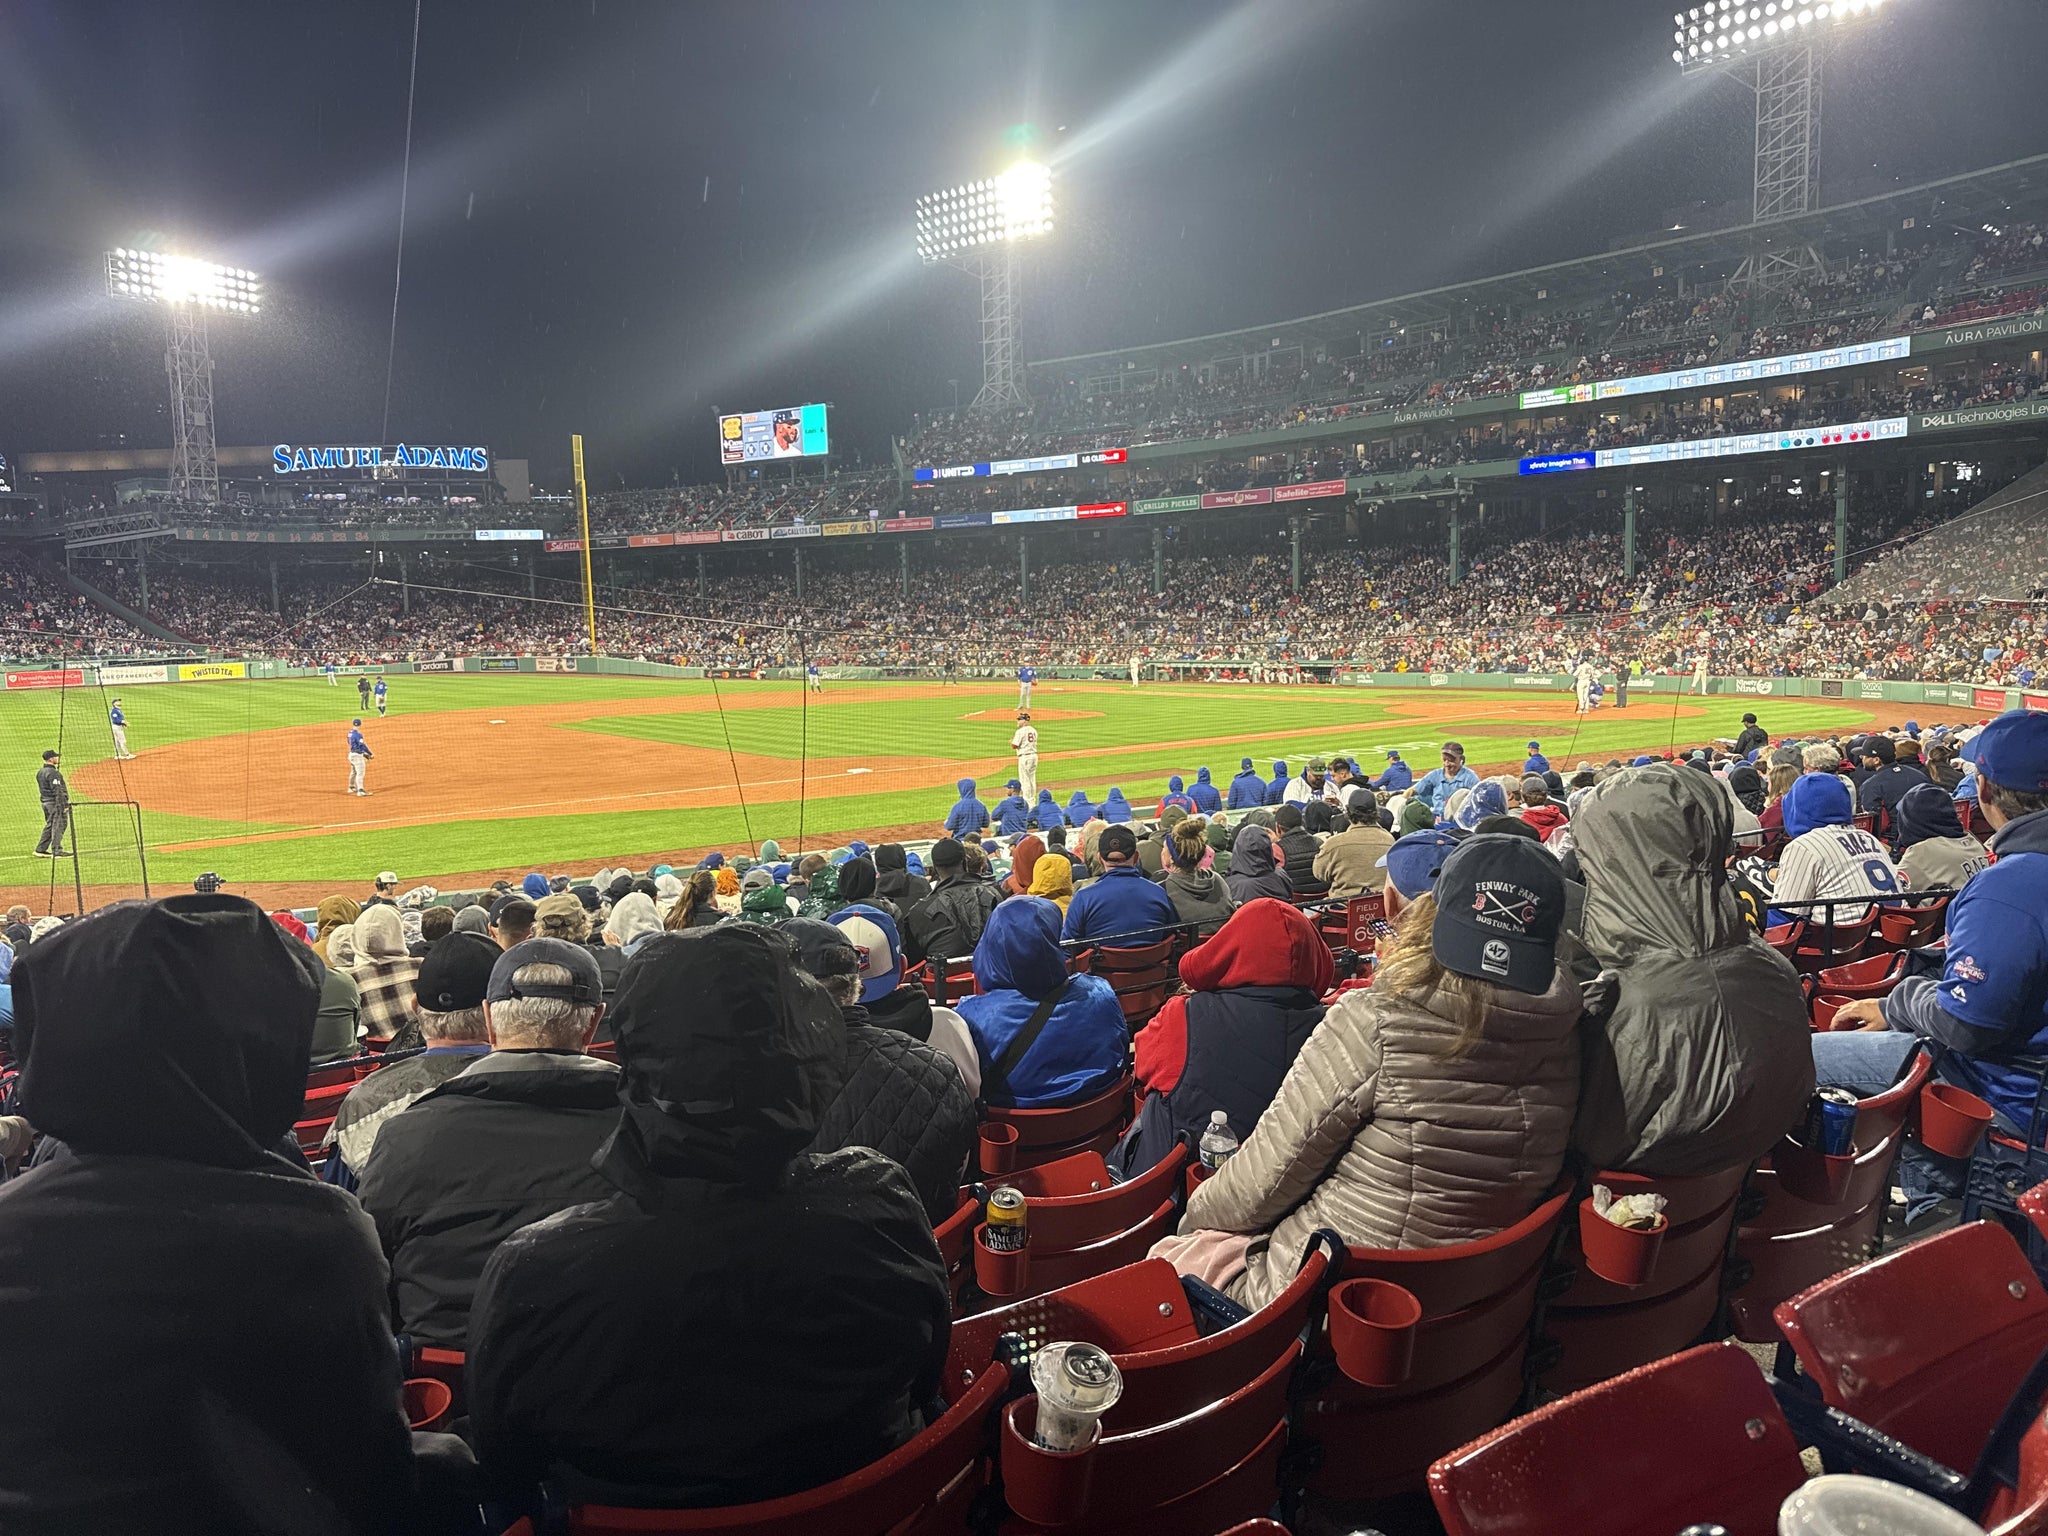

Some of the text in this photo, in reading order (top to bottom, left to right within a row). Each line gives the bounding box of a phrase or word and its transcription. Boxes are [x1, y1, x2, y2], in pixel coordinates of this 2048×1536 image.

[1986, 320, 2042, 338] PAVILION
[1602, 386, 1625, 396] STORY
[1419, 408, 1453, 420] PAVILION
[1922, 414, 1955, 428] DELL
[1955, 406, 2028, 424] Technologies
[1819, 425, 1845, 434] STRIKE
[1852, 423, 1868, 431] OUT
[1881, 422, 1903, 434] 6TH
[1740, 439, 1758, 448] MVR
[273, 443, 488, 473] SAMUEL ADAMS
[1529, 457, 1586, 470] xfinity Imagine That
[941, 465, 975, 478] UNITED
[1215, 493, 1258, 504] Ninety Nine
[1276, 488, 1309, 499] Safelite
[1171, 499, 1198, 508] PICKLES
[564, 542, 580, 550] PIZZA
[191, 668, 233, 678] TWISTED TEA
[1513, 676, 1553, 685] smartwater
[1735, 678, 1752, 687] Ninety
[1736, 685, 1757, 693] Nine
[1861, 682, 1883, 691] WM
[1837, 833, 1881, 857] BAEZ
[1863, 860, 1898, 894] 9
[1475, 880, 1541, 906] FENWAY PARK
[1356, 902, 1379, 912] FIELD
[1472, 893, 1486, 911] B
[1359, 912, 1376, 922] BOX
[1521, 906, 1536, 922] C
[1512, 923, 1526, 933] MA
[987, 1227, 1023, 1244] SAMUEL
[989, 1240, 1021, 1251] ADAMS
